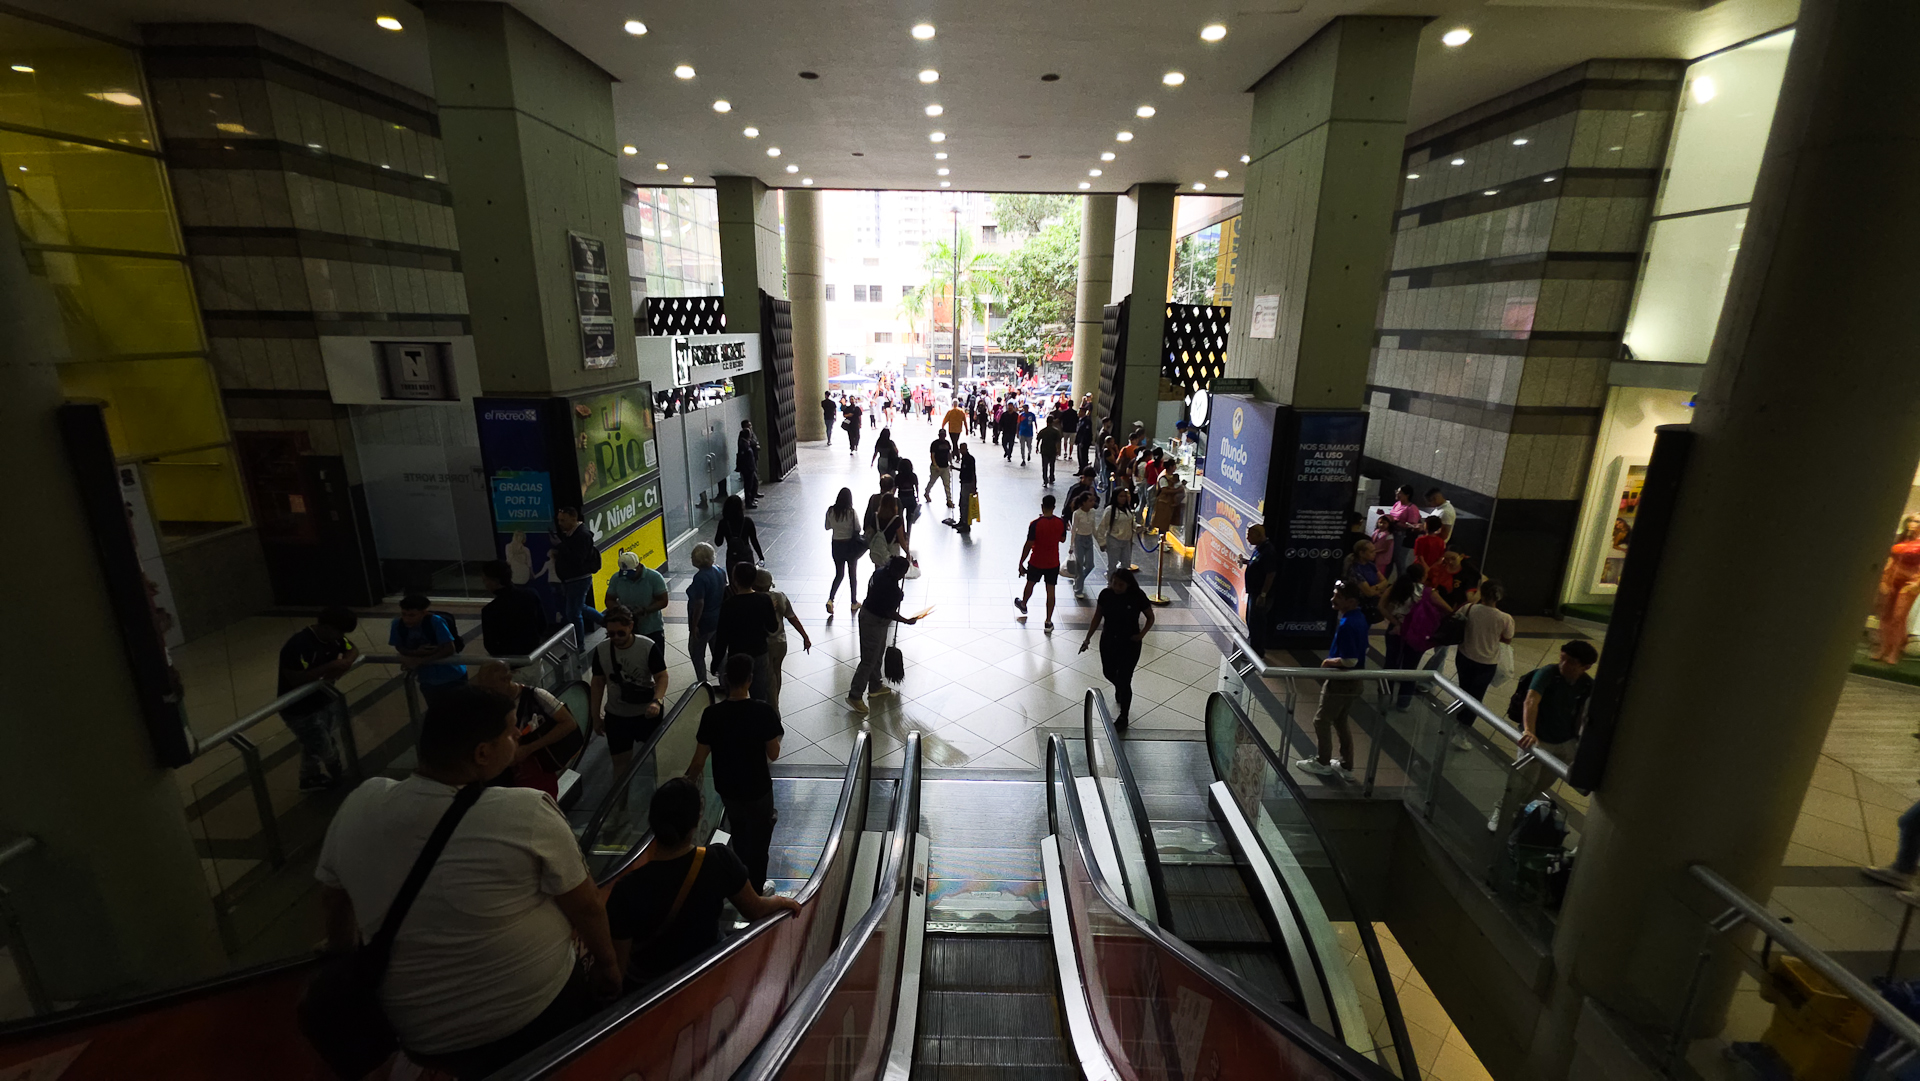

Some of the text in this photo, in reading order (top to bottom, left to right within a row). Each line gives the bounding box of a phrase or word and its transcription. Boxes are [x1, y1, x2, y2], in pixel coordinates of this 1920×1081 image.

[484, 409, 525, 421] el recreo
[1220, 436, 1248, 466] Mundo
[1318, 443, 1360, 451] SUMAMOS
[1325, 451, 1343, 459] USO
[1344, 459, 1351, 467] Y
[1220, 457, 1244, 486] Escolar
[1304, 466, 1346, 474] RACIONAL
[1297, 473, 1352, 482] DE LA ENERGÍA
[499, 483, 543, 492] GRACIAS
[505, 496, 541, 505] POR TU
[606, 496, 636, 531] Nivel
[644, 485, 657, 508] C1
[508, 509, 539, 518] VISITA
[1276, 620, 1287, 630] el
